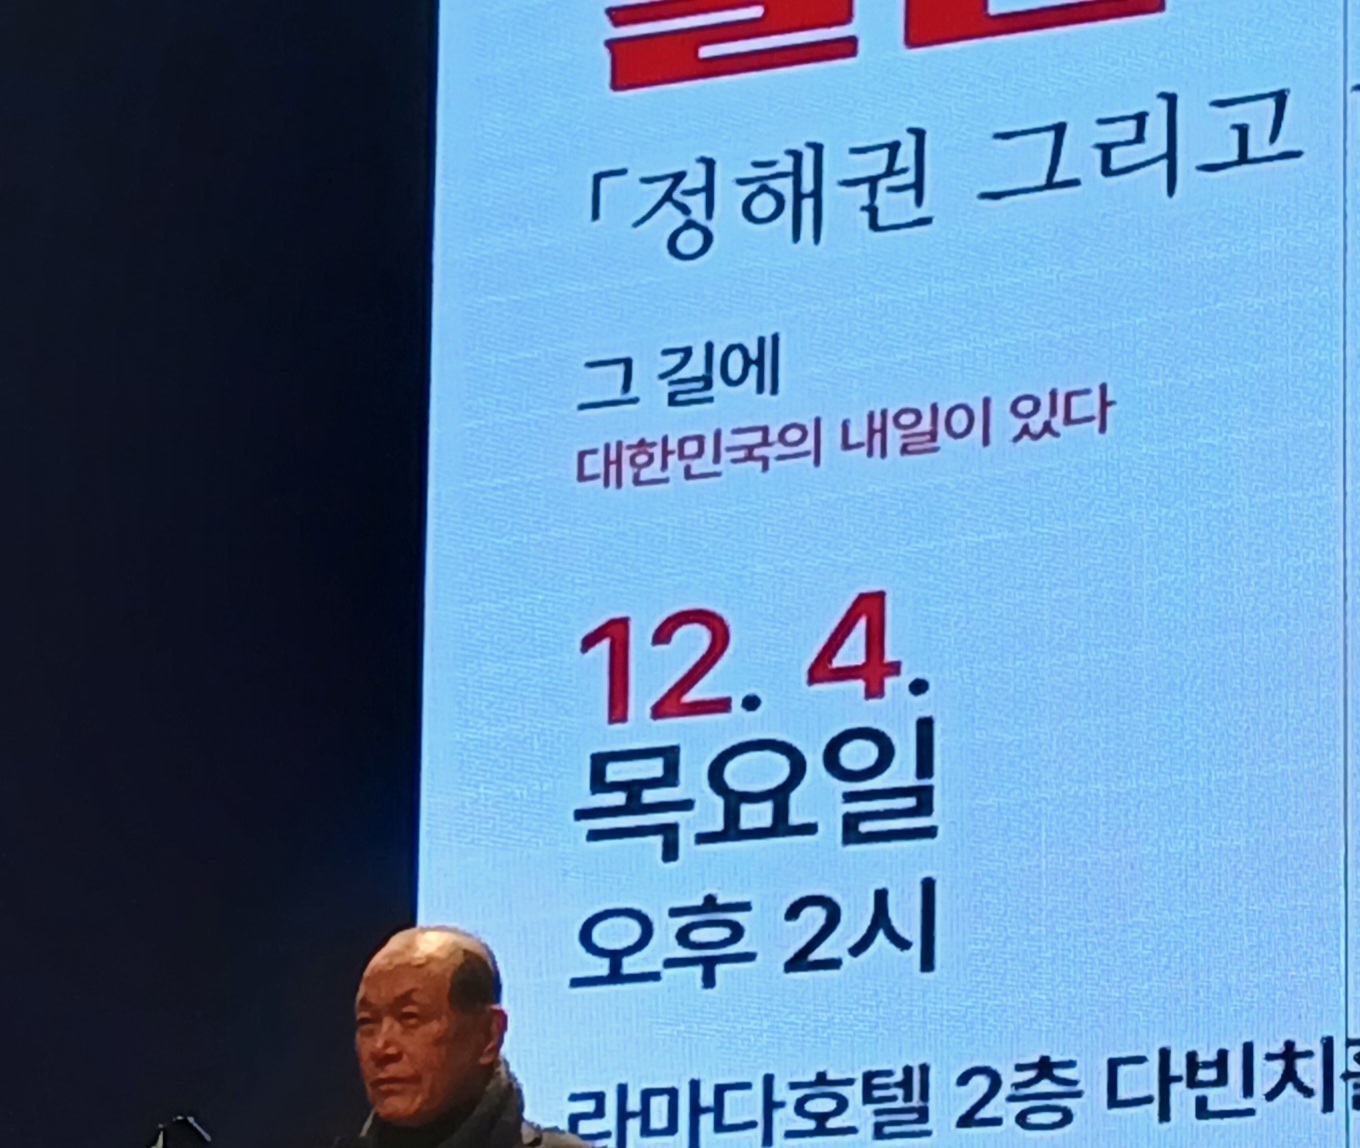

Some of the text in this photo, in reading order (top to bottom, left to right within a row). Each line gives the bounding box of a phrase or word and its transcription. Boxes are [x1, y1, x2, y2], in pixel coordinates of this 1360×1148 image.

[976, 88, 1304, 200] 그리고
[576, 332, 782, 411] 그 길에
[576, 382, 1117, 490] 대한민국의 내일이 있다
[579, 590, 931, 724] 12. 4.
[573, 716, 939, 864] 목요일
[568, 877, 938, 990] 오후 2시
[955, 1056, 1083, 1133] 2층
